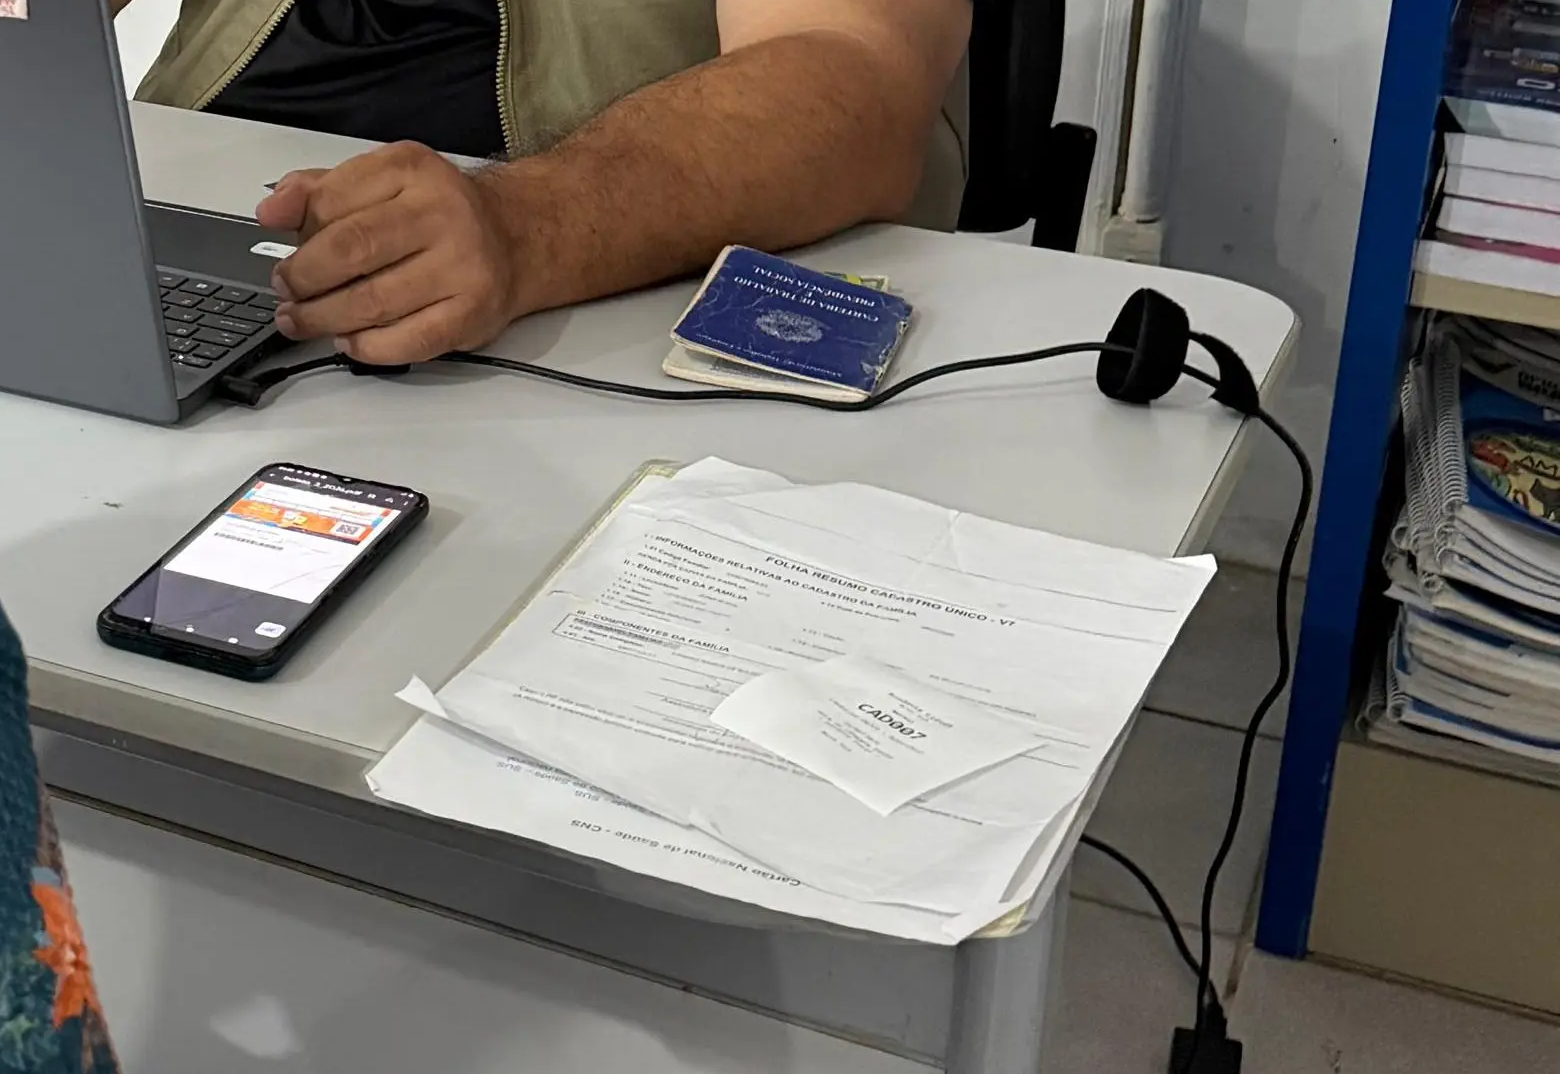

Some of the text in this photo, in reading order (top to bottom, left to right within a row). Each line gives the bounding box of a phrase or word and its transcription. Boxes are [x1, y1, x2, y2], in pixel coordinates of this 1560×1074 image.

[752, 264, 795, 286] SOCIAL
[733, 276, 880, 323] CARTEIRA DE TRABALHO
[636, 562, 690, 585] ENDEREÇO
[691, 579, 706, 589] DA
[707, 583, 748, 602] FAMÍLIA
[655, 535, 725, 564] INFORMAÇÕES
[726, 559, 782, 581] RELATIVAS
[783, 578, 800, 587] AO
[801, 582, 858, 604] CADASTRO
[764, 555, 810, 575] FOLHA
[811, 569, 868, 593] RESUMO
[870, 588, 941, 610] CADASTRO
[945, 603, 988, 622] ÚNICO
[593, 613, 669, 638] COMPONENTES
[671, 634, 686, 643] DA
[688, 637, 731, 653] FAMÍLIA
[857, 702, 928, 740] CAD007
[570, 818, 602, 834] CNS
[615, 830, 662, 848] Saúde
[663, 843, 681, 855] de
[683, 848, 748, 873] Nacional
[751, 866, 801, 887] Cartão
